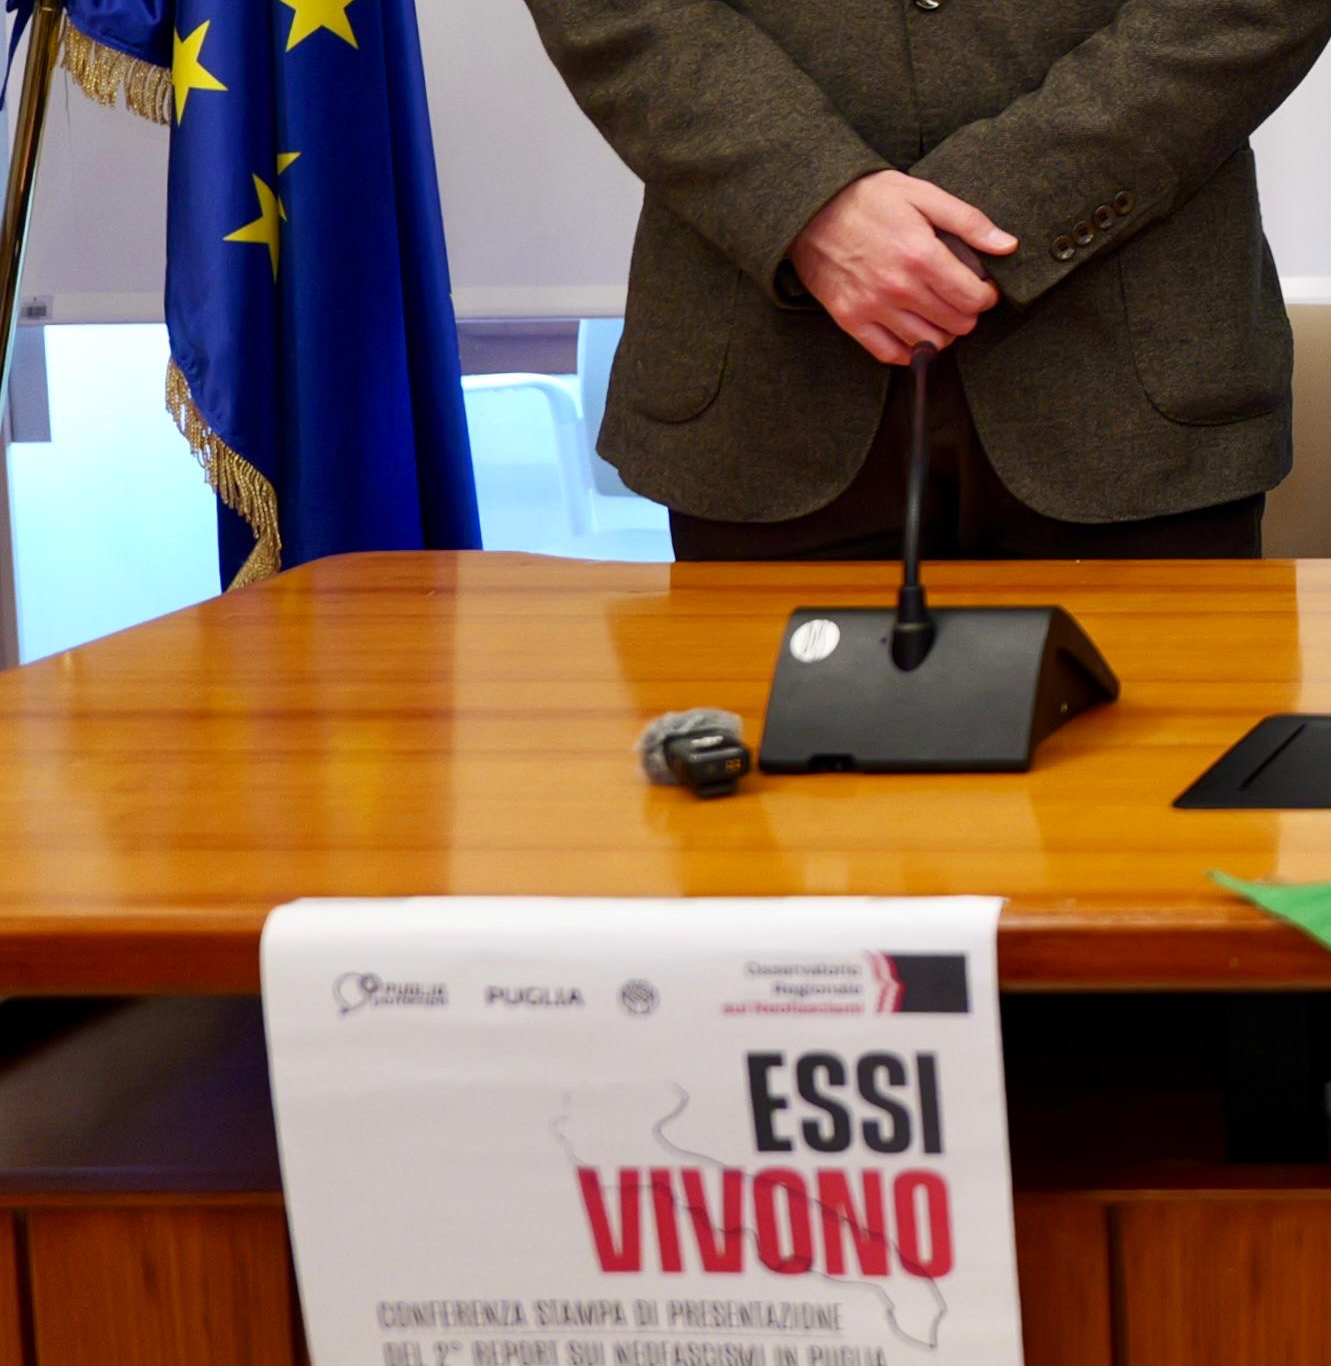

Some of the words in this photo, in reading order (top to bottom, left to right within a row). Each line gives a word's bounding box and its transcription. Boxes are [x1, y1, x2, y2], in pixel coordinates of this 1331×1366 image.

[484, 984, 585, 1006] PUGLIA
[745, 1051, 945, 1155] ESSI
[576, 1166, 954, 1279] VIVONO
[377, 1299, 528, 1329] CONFERENZA
[533, 1298, 628, 1327] STAMPA
[632, 1298, 660, 1327] DI
[666, 1298, 845, 1331] PRESENTAZIONE
[383, 1340, 424, 1366] DEL
[471, 1339, 560, 1366] REPORT
[564, 1340, 605, 1366] SUI
[612, 1340, 767, 1366] NEOFASCISMI
[773, 1342, 798, 1366] IN
[805, 1343, 889, 1366] PUGLIA
